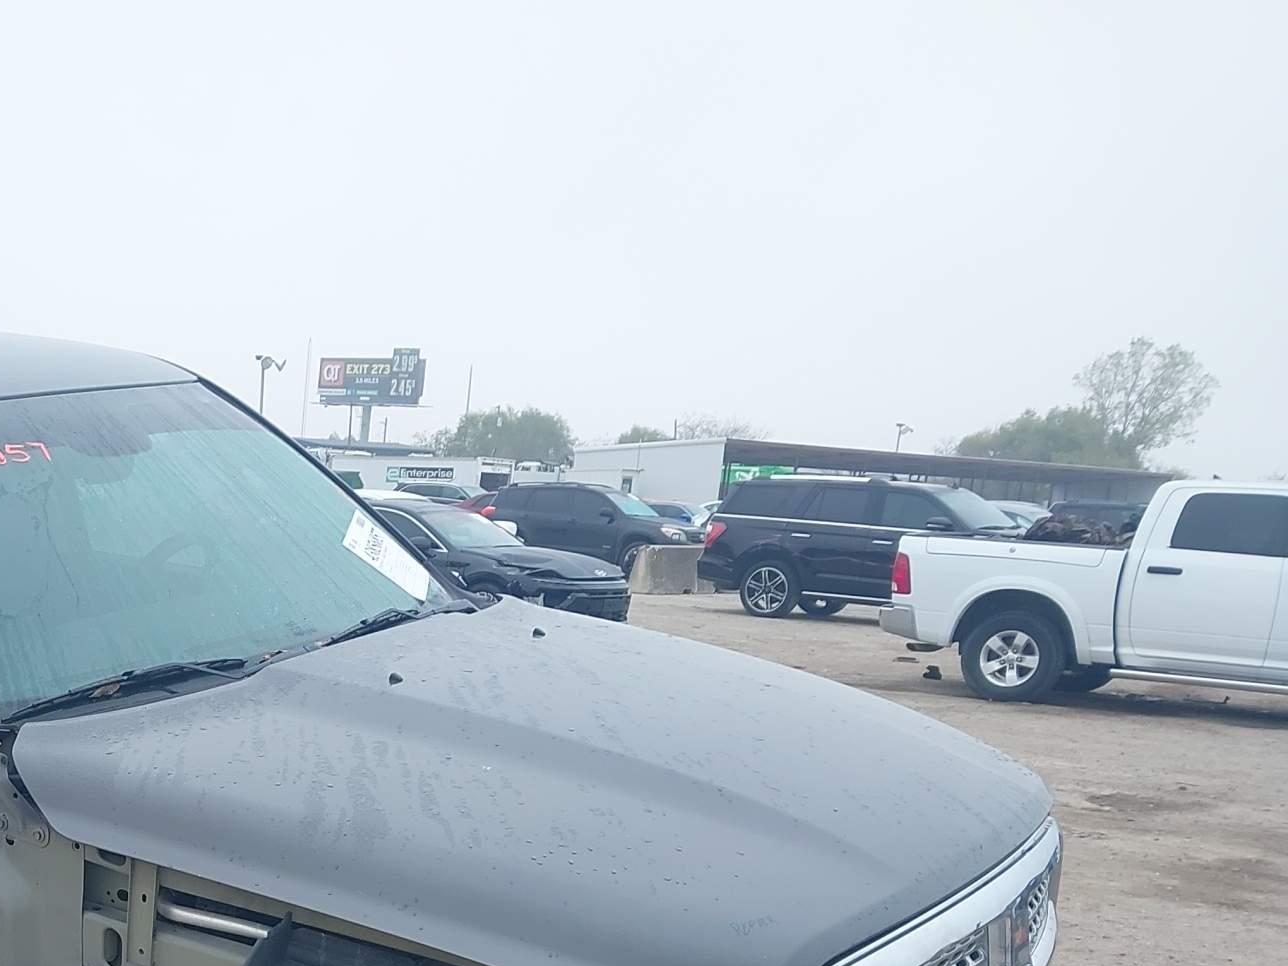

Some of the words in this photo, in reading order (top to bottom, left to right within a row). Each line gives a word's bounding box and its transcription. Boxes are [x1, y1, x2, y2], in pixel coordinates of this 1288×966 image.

[324, 364, 341, 381] QT
[346, 364, 370, 375] EXIT
[371, 364, 391, 375] 273
[400, 467, 453, 479] Enterprise
